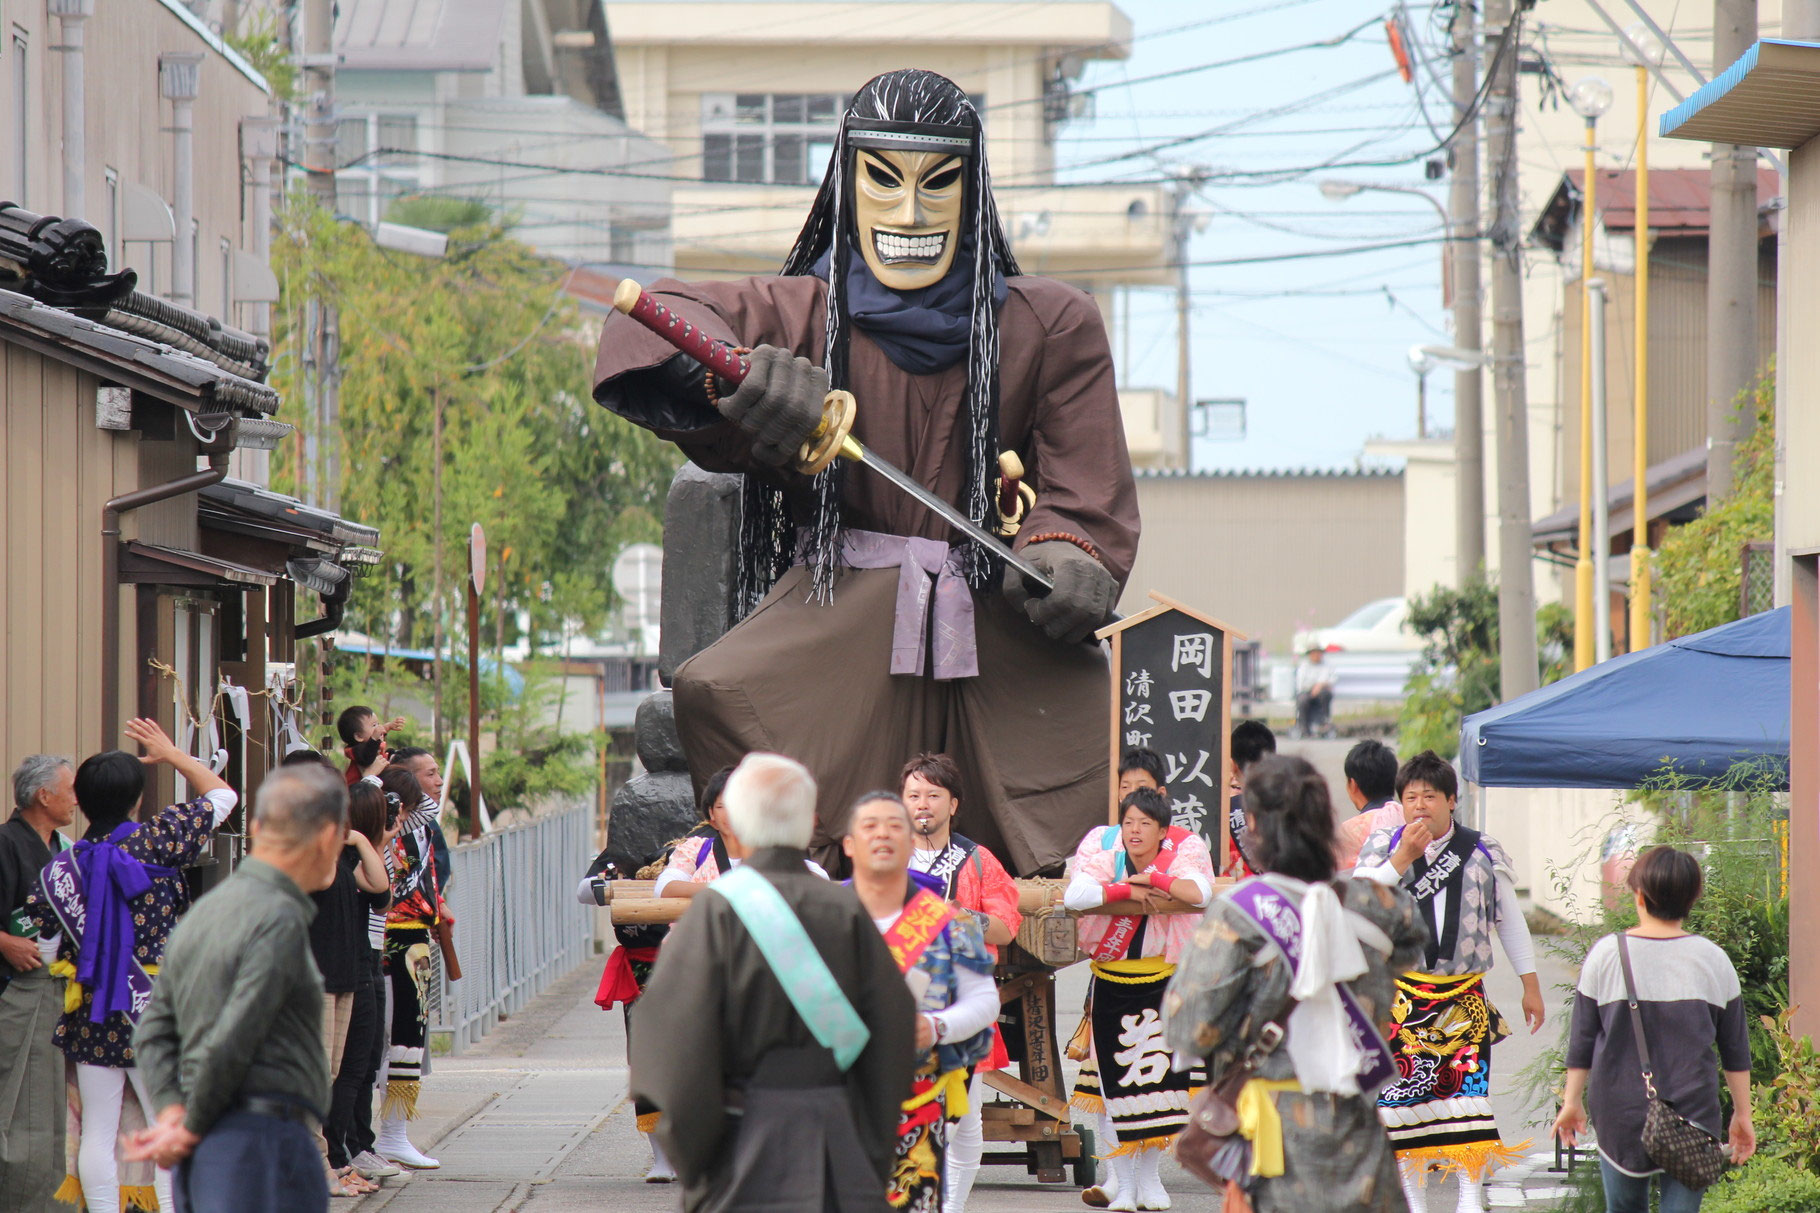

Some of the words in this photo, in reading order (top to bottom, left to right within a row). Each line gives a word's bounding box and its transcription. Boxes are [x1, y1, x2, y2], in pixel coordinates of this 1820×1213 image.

[1125, 669, 1155, 748] 清沢町
[1165, 633, 1214, 852] 岡田以蔵
[1415, 850, 1462, 900] 清沢町
[1113, 1009, 1172, 1087] 若
